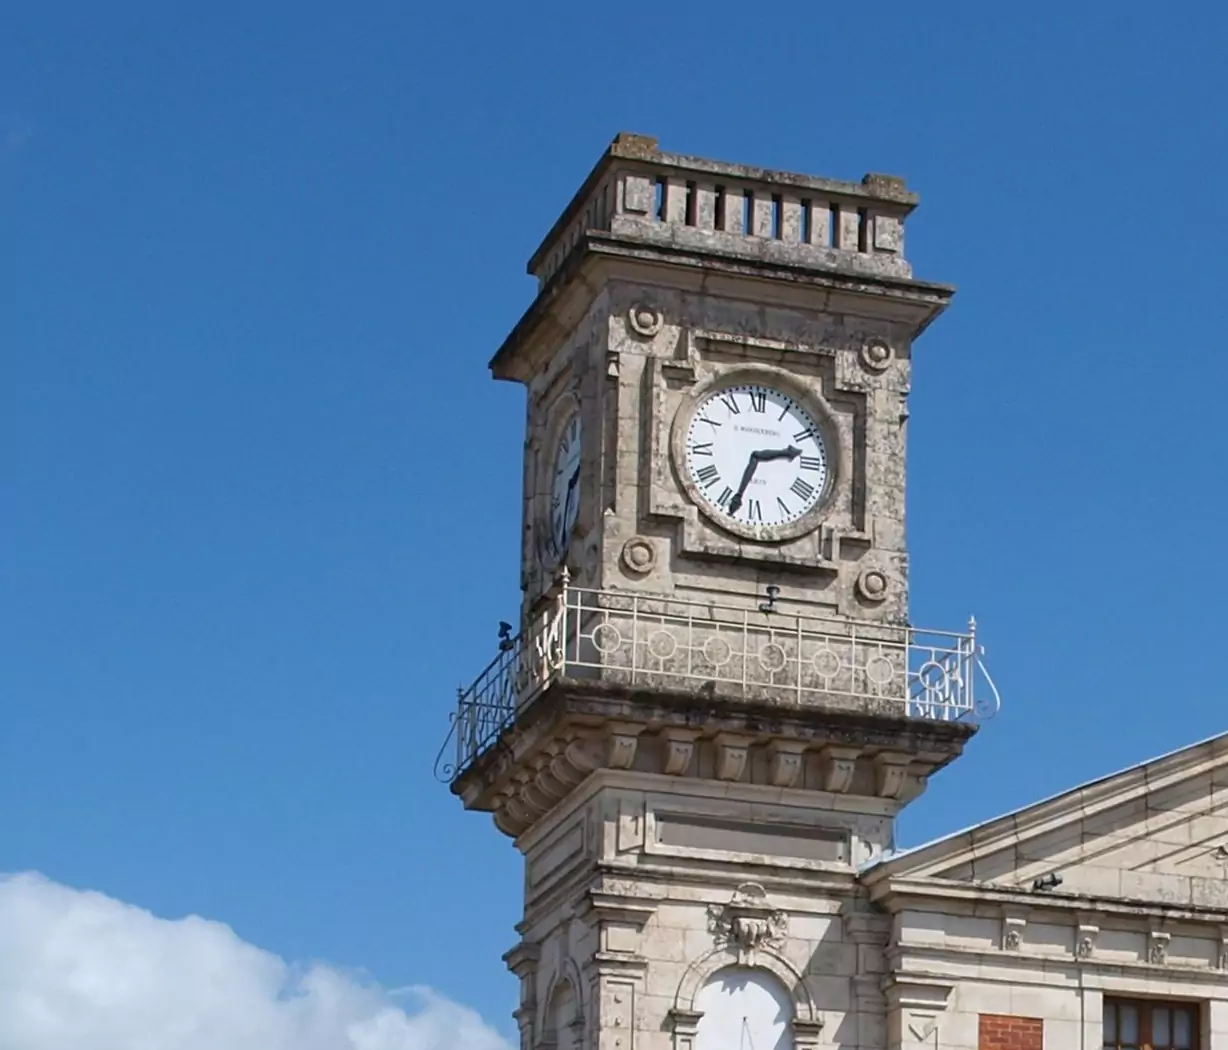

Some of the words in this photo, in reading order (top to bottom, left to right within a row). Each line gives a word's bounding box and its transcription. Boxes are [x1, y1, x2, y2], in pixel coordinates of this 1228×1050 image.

[748, 391, 767, 413] XII
[793, 428, 814, 443] II
[800, 456, 820, 471] III
[790, 477, 815, 502] IIII
